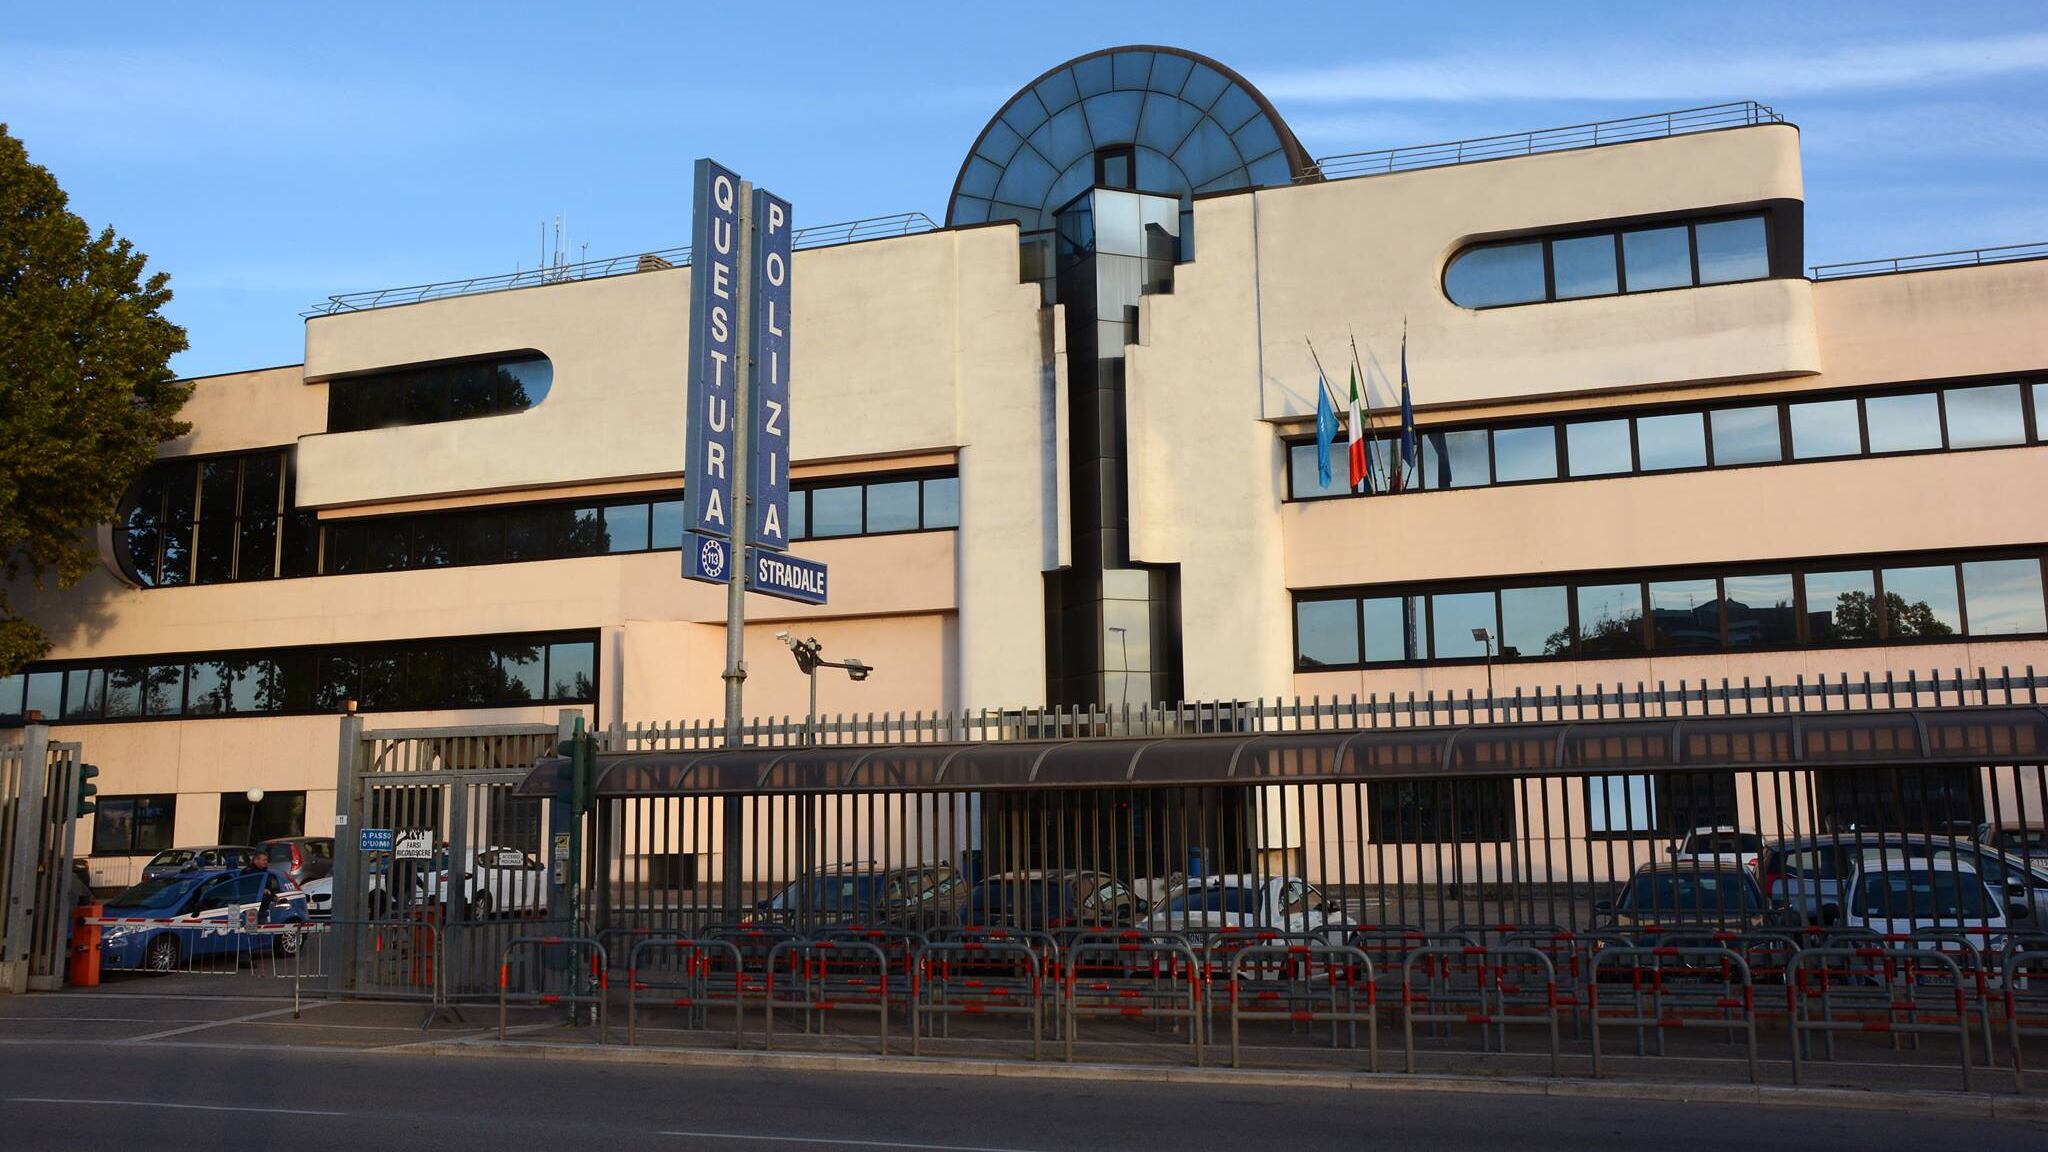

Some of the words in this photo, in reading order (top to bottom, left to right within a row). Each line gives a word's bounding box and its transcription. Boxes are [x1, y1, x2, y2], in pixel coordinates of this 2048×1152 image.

[705, 175, 734, 527] QUESTURA
[763, 202, 785, 539] POLIZIA
[706, 552, 719, 566] 113
[759, 557, 825, 595] STRADALE
[369, 832, 392, 840] PASSO
